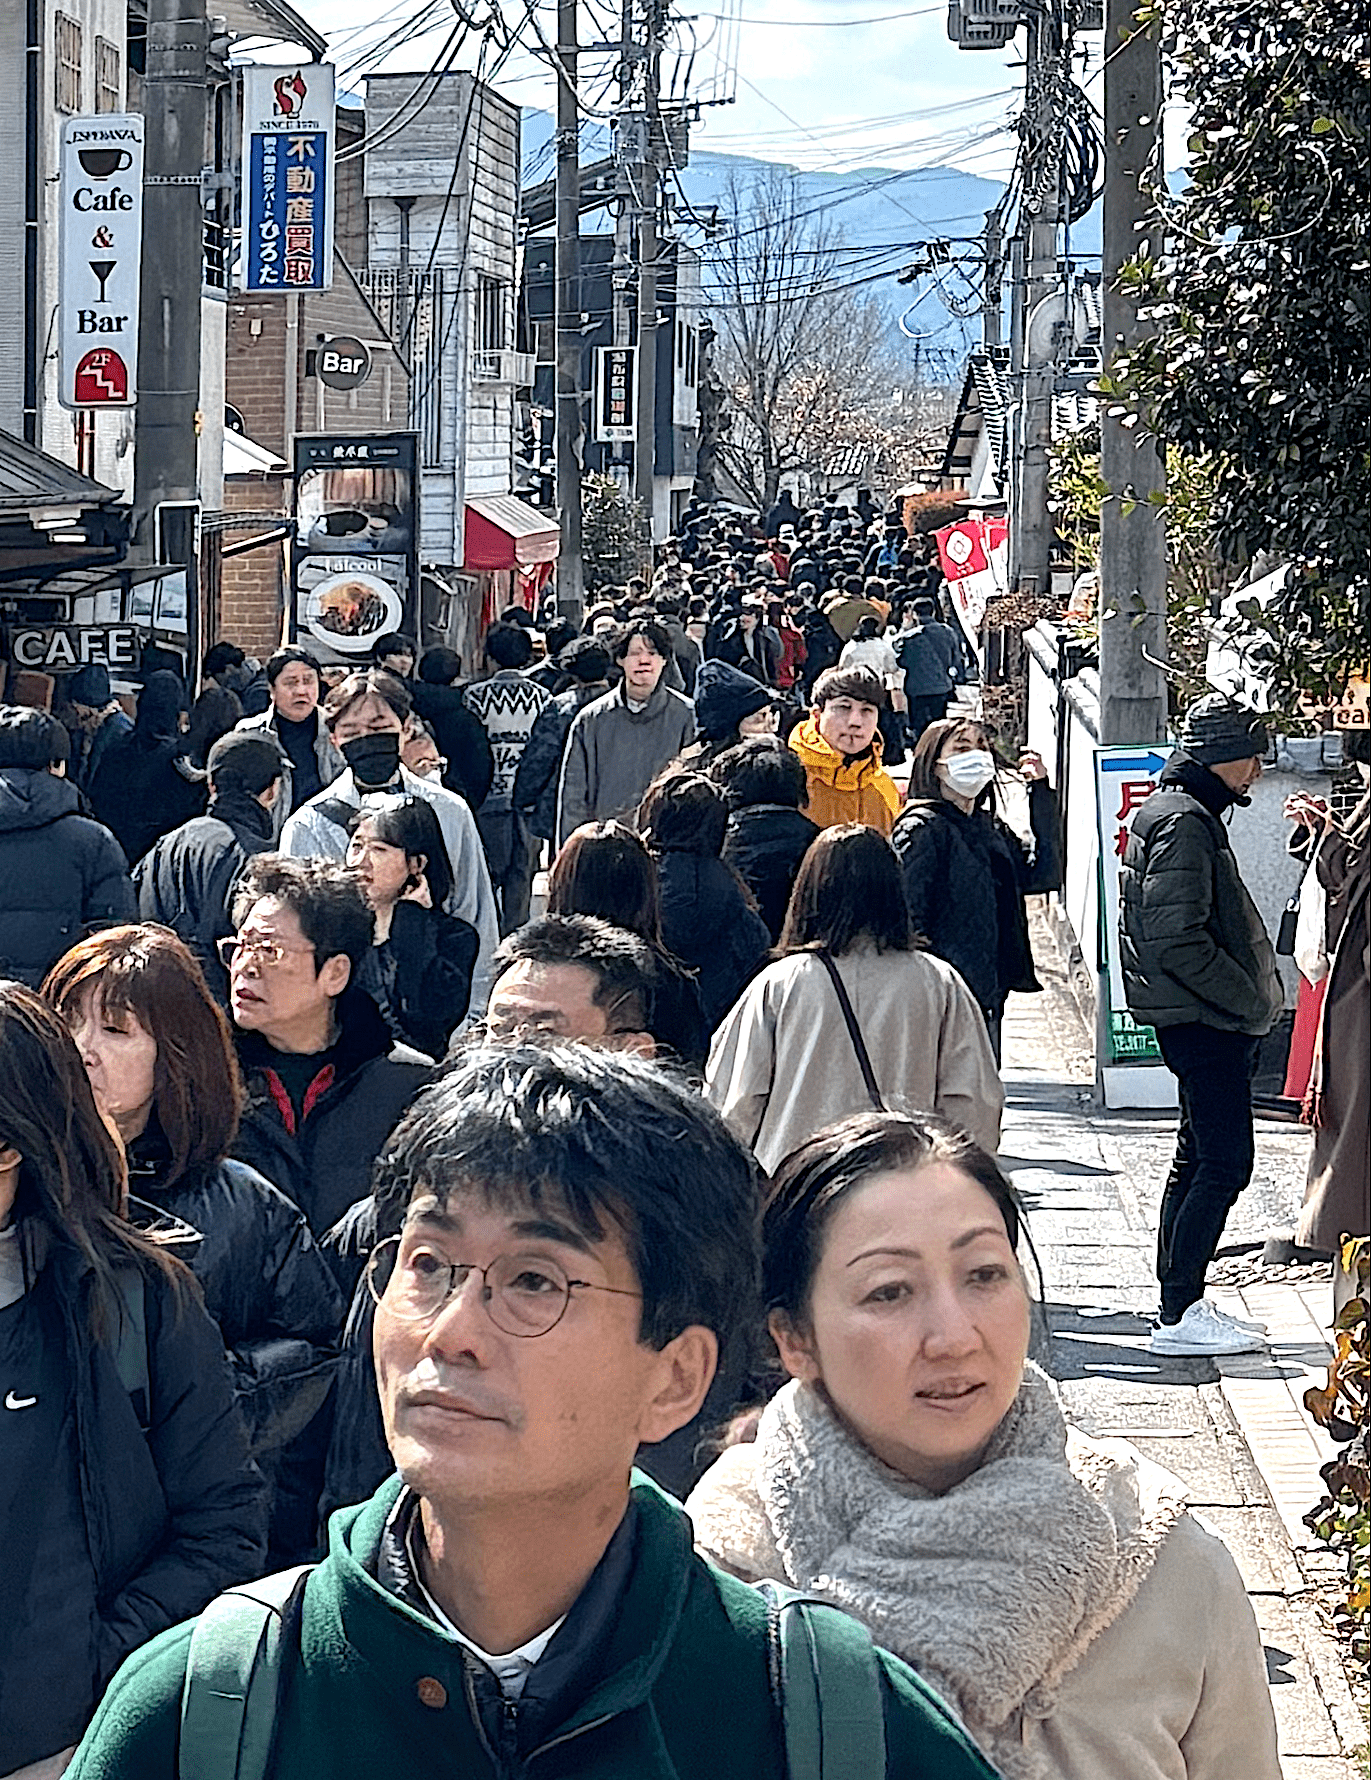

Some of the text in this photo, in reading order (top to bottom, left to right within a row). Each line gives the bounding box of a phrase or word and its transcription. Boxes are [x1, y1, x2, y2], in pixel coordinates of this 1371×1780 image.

[73, 187, 133, 211] Cafe
[284, 135, 317, 285] 不動産買取
[92, 225, 114, 248] &
[76, 310, 129, 334] Bar
[90, 353, 111, 366] 2F
[322, 351, 365, 374] Bar
[14, 629, 132, 665] CAFE
